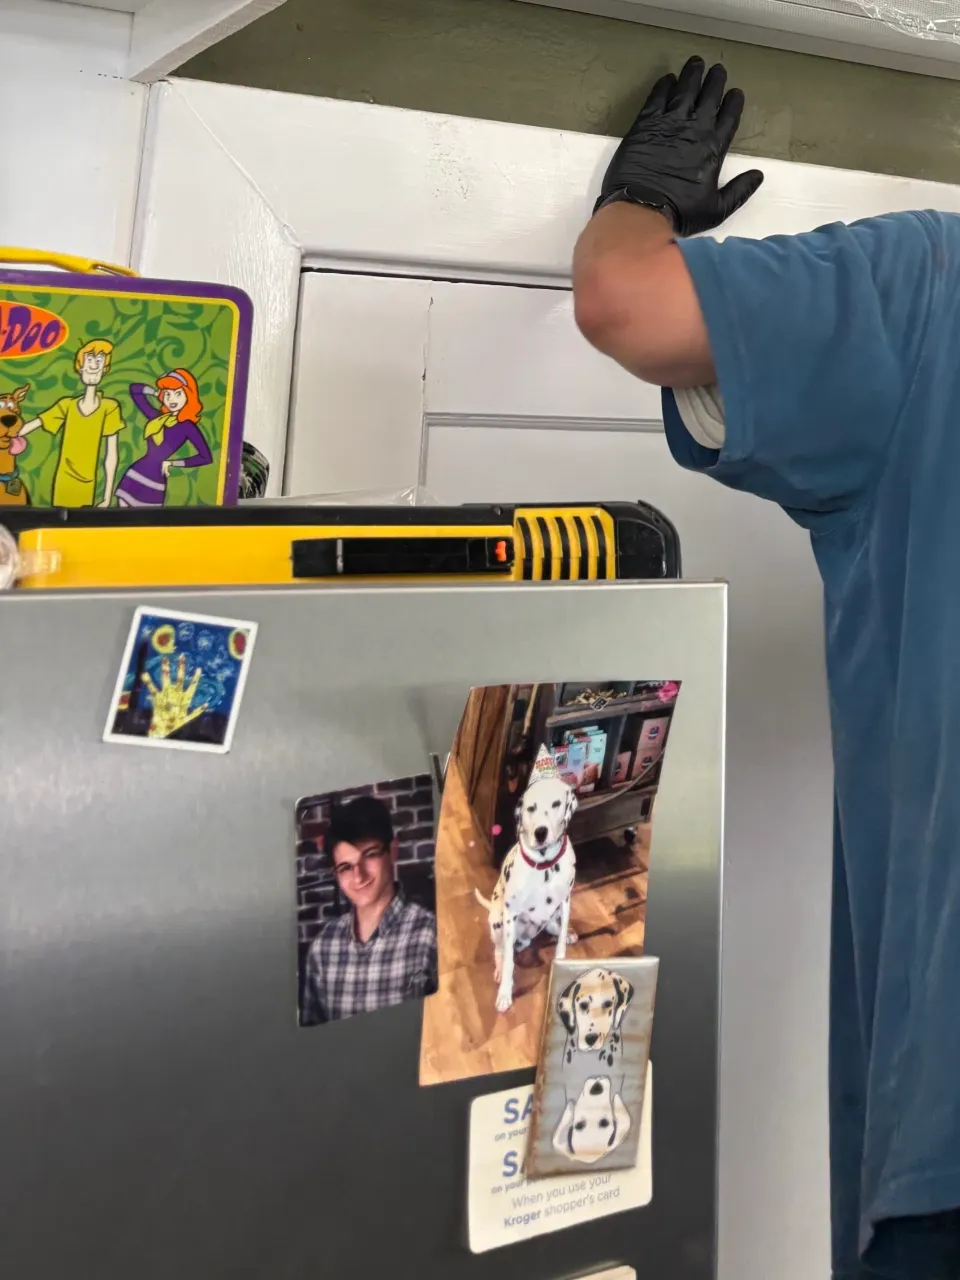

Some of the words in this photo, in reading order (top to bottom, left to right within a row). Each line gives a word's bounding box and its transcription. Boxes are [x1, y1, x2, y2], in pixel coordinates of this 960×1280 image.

[494, 1131, 507, 1142] on
[508, 1126, 527, 1140] your
[502, 1150, 525, 1178] S
[491, 1184, 503, 1195] on
[504, 1179, 524, 1193] your
[511, 1192, 543, 1210] When
[546, 1186, 566, 1202] you
[568, 1180, 587, 1193] use
[589, 1173, 613, 1190] your
[503, 1209, 542, 1228] Kroger
[543, 1193, 595, 1218] shopper's
[597, 1186, 620, 1202] card
